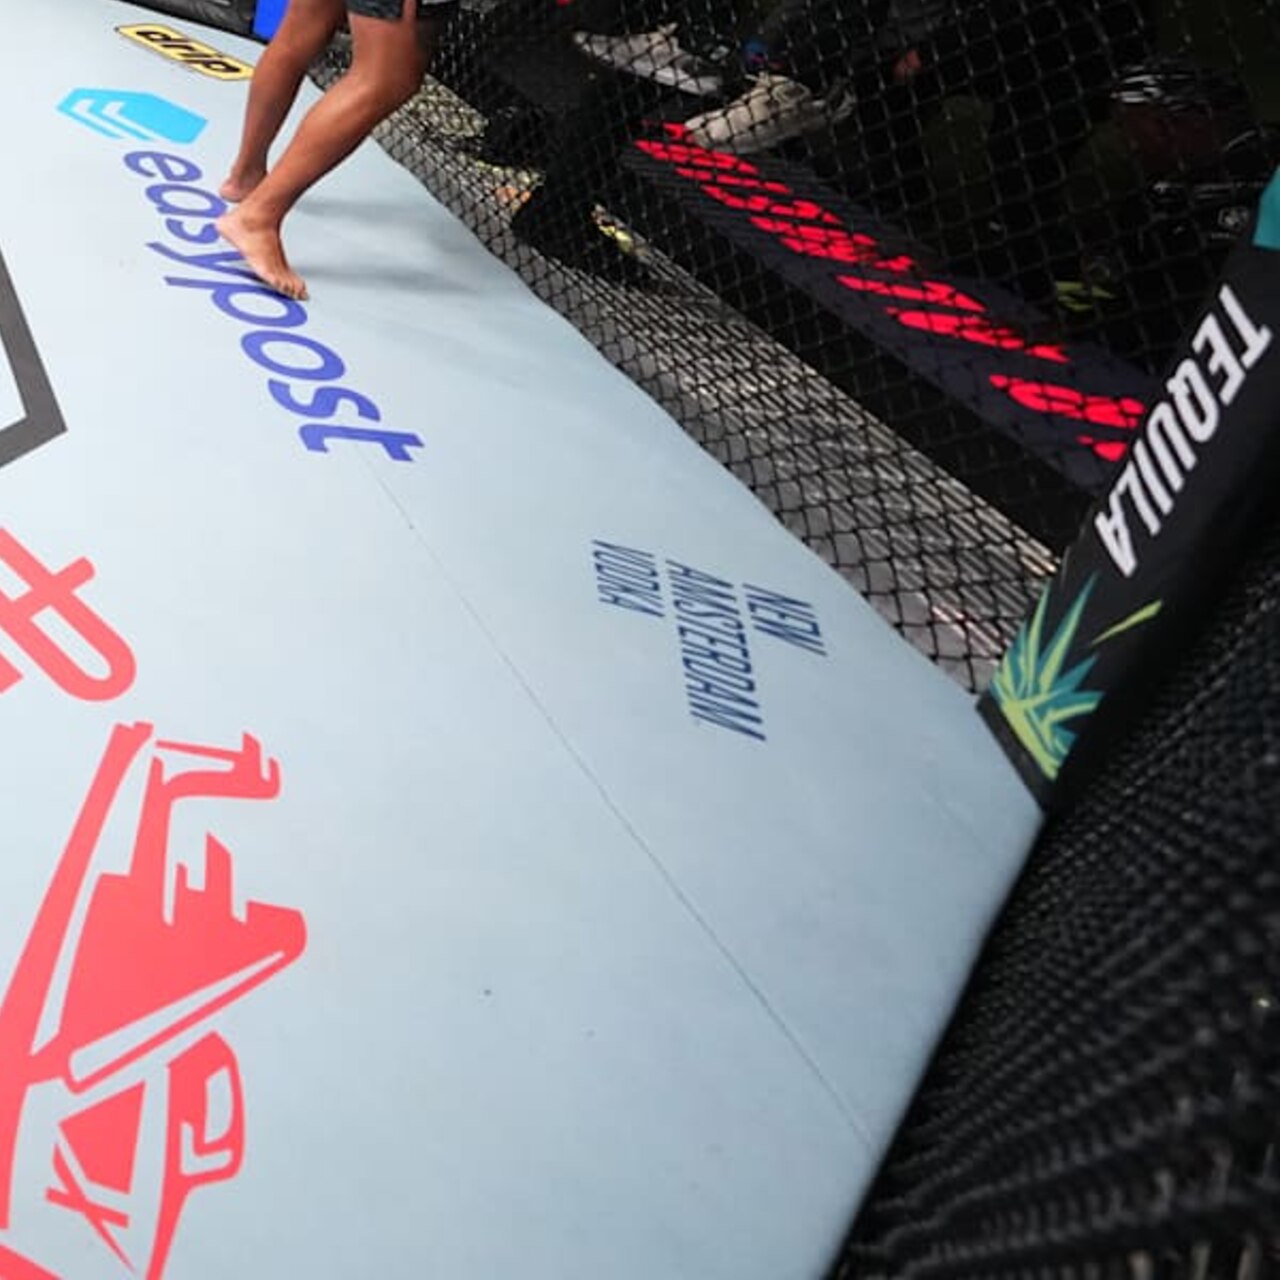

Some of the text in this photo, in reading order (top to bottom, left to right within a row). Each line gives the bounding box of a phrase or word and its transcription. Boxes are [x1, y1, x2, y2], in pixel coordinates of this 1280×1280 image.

[136, 26, 244, 77] drip
[122, 149, 426, 462] easypost
[1094, 283, 1274, 579] TEQUILA
[665, 557, 768, 742] AMSTERDAM
[742, 581, 829, 657] NEW
